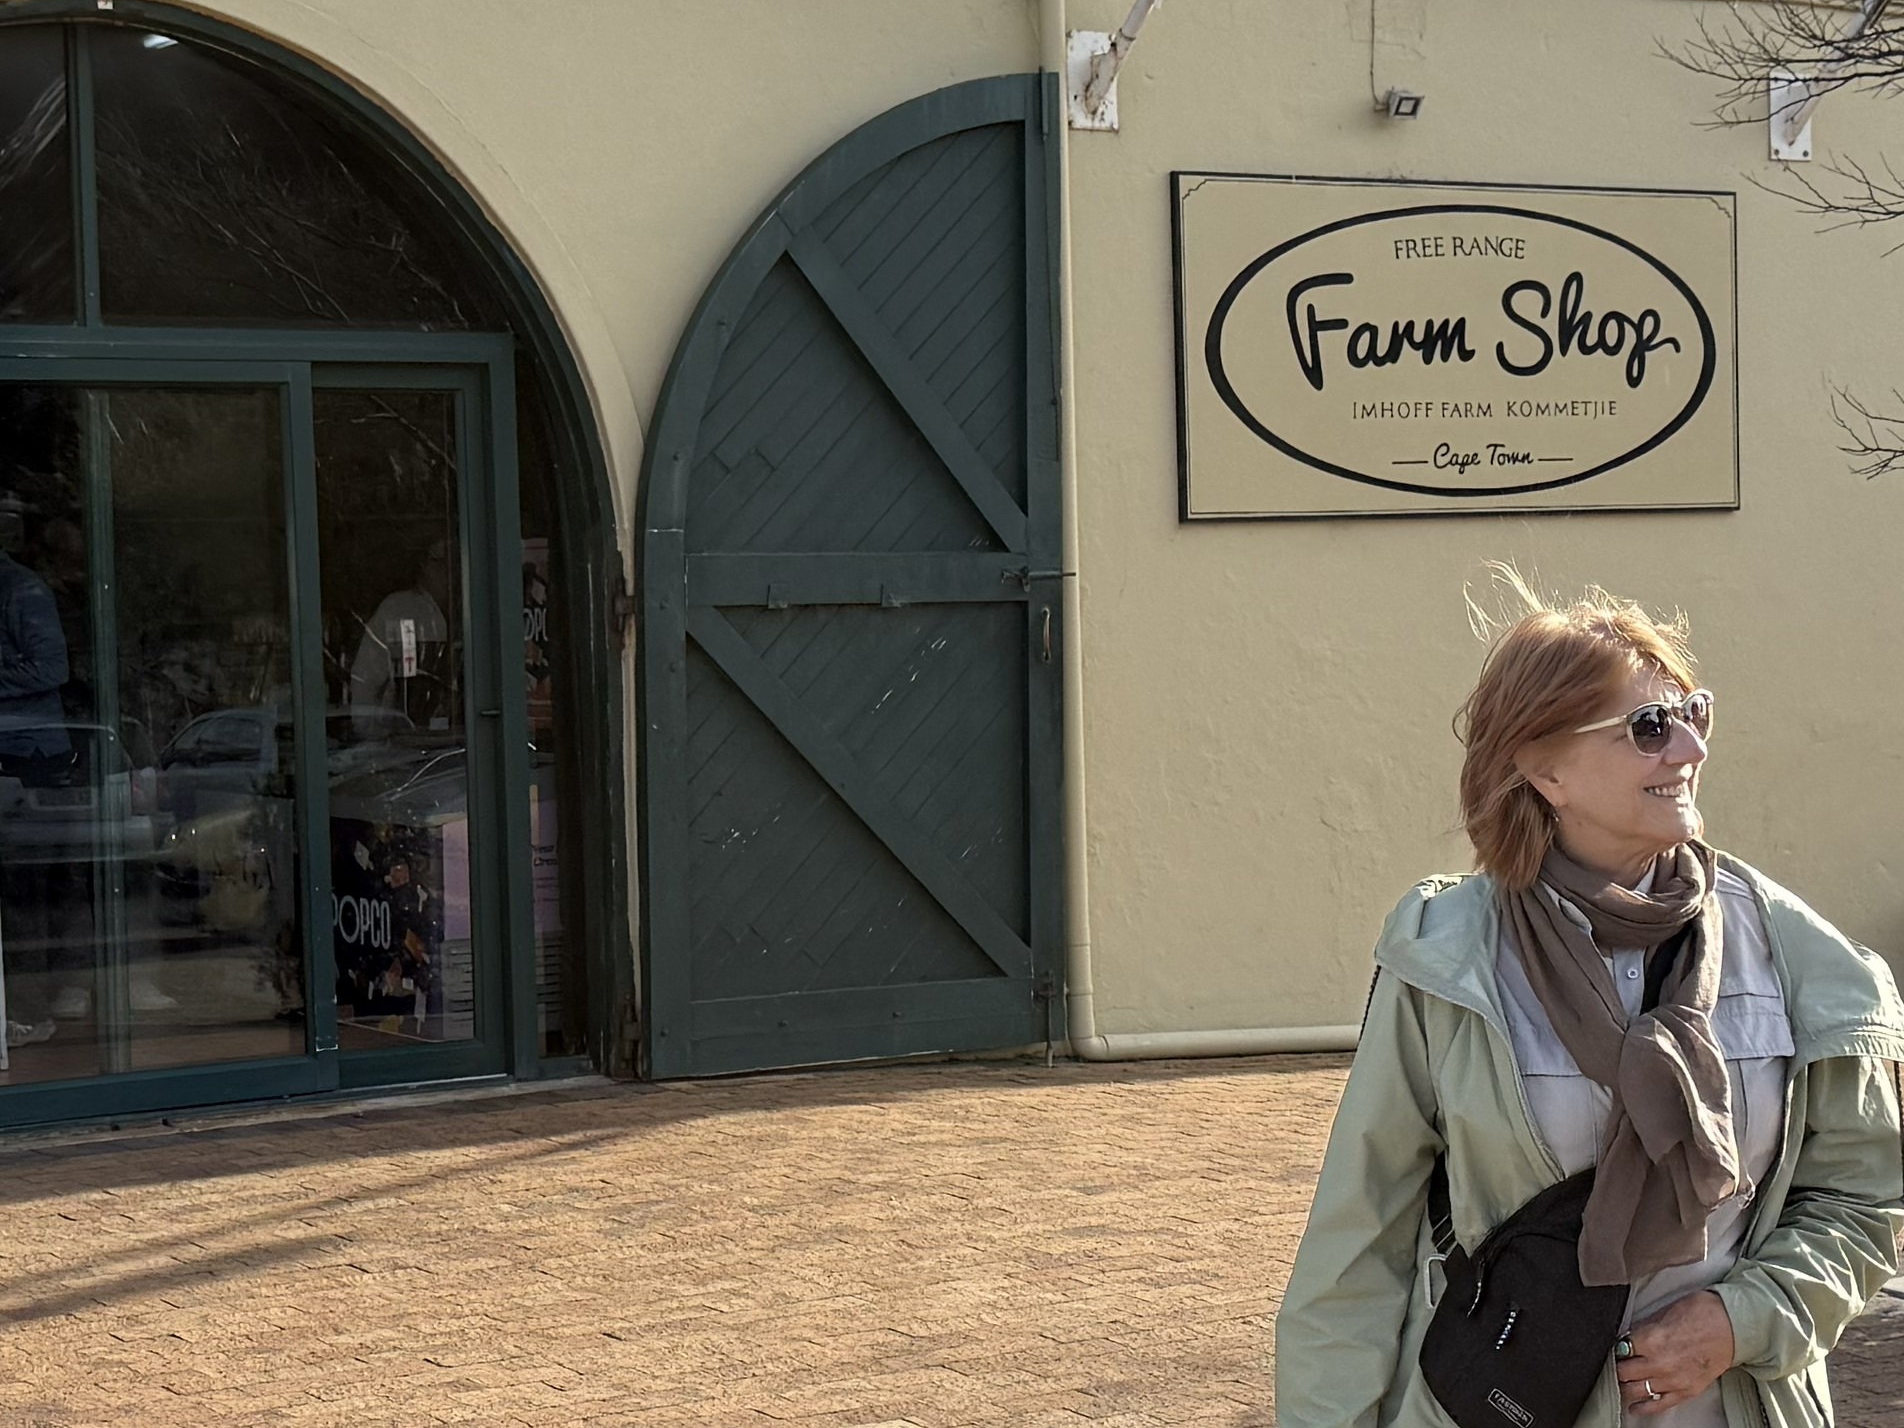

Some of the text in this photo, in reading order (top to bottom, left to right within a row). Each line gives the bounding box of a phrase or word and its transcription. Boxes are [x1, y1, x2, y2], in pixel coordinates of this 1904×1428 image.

[1393, 235, 1526, 259] FREE RANGE
[1286, 271, 1681, 391] Farm Shop
[1352, 399, 1618, 421] IMHOFF FARM KOMMETJIE
[1433, 442, 1535, 475] Cape Town
